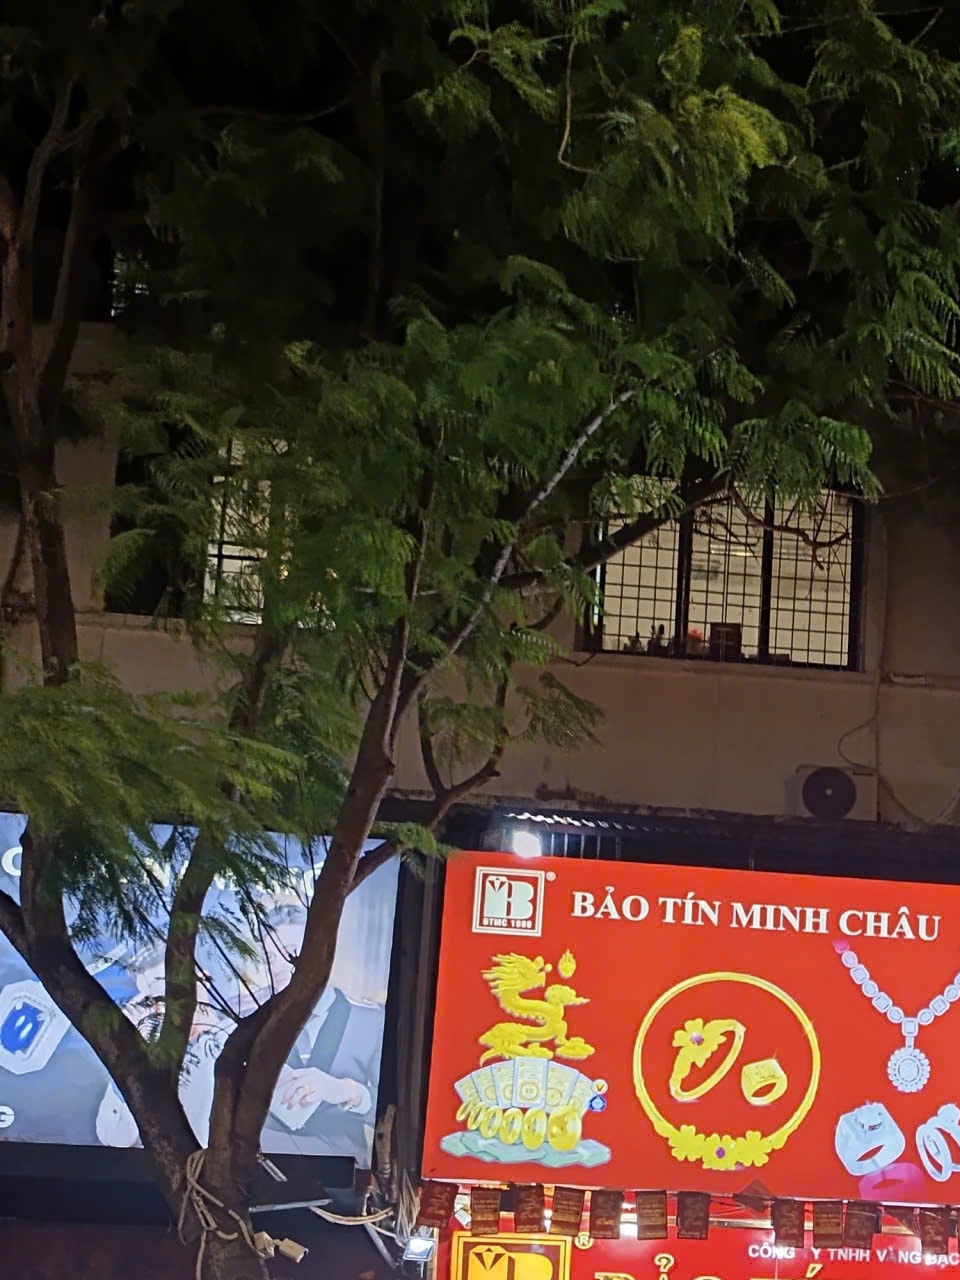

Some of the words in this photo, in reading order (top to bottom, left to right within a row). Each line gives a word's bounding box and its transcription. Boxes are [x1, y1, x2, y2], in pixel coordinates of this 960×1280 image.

[571, 885, 650, 922] BẢO
[658, 891, 722, 928] TÍN
[730, 902, 830, 934] MINH
[838, 905, 941, 941] CHÂU
[748, 1243, 796, 1260] CÔNG
[828, 1248, 871, 1263] TNHH
